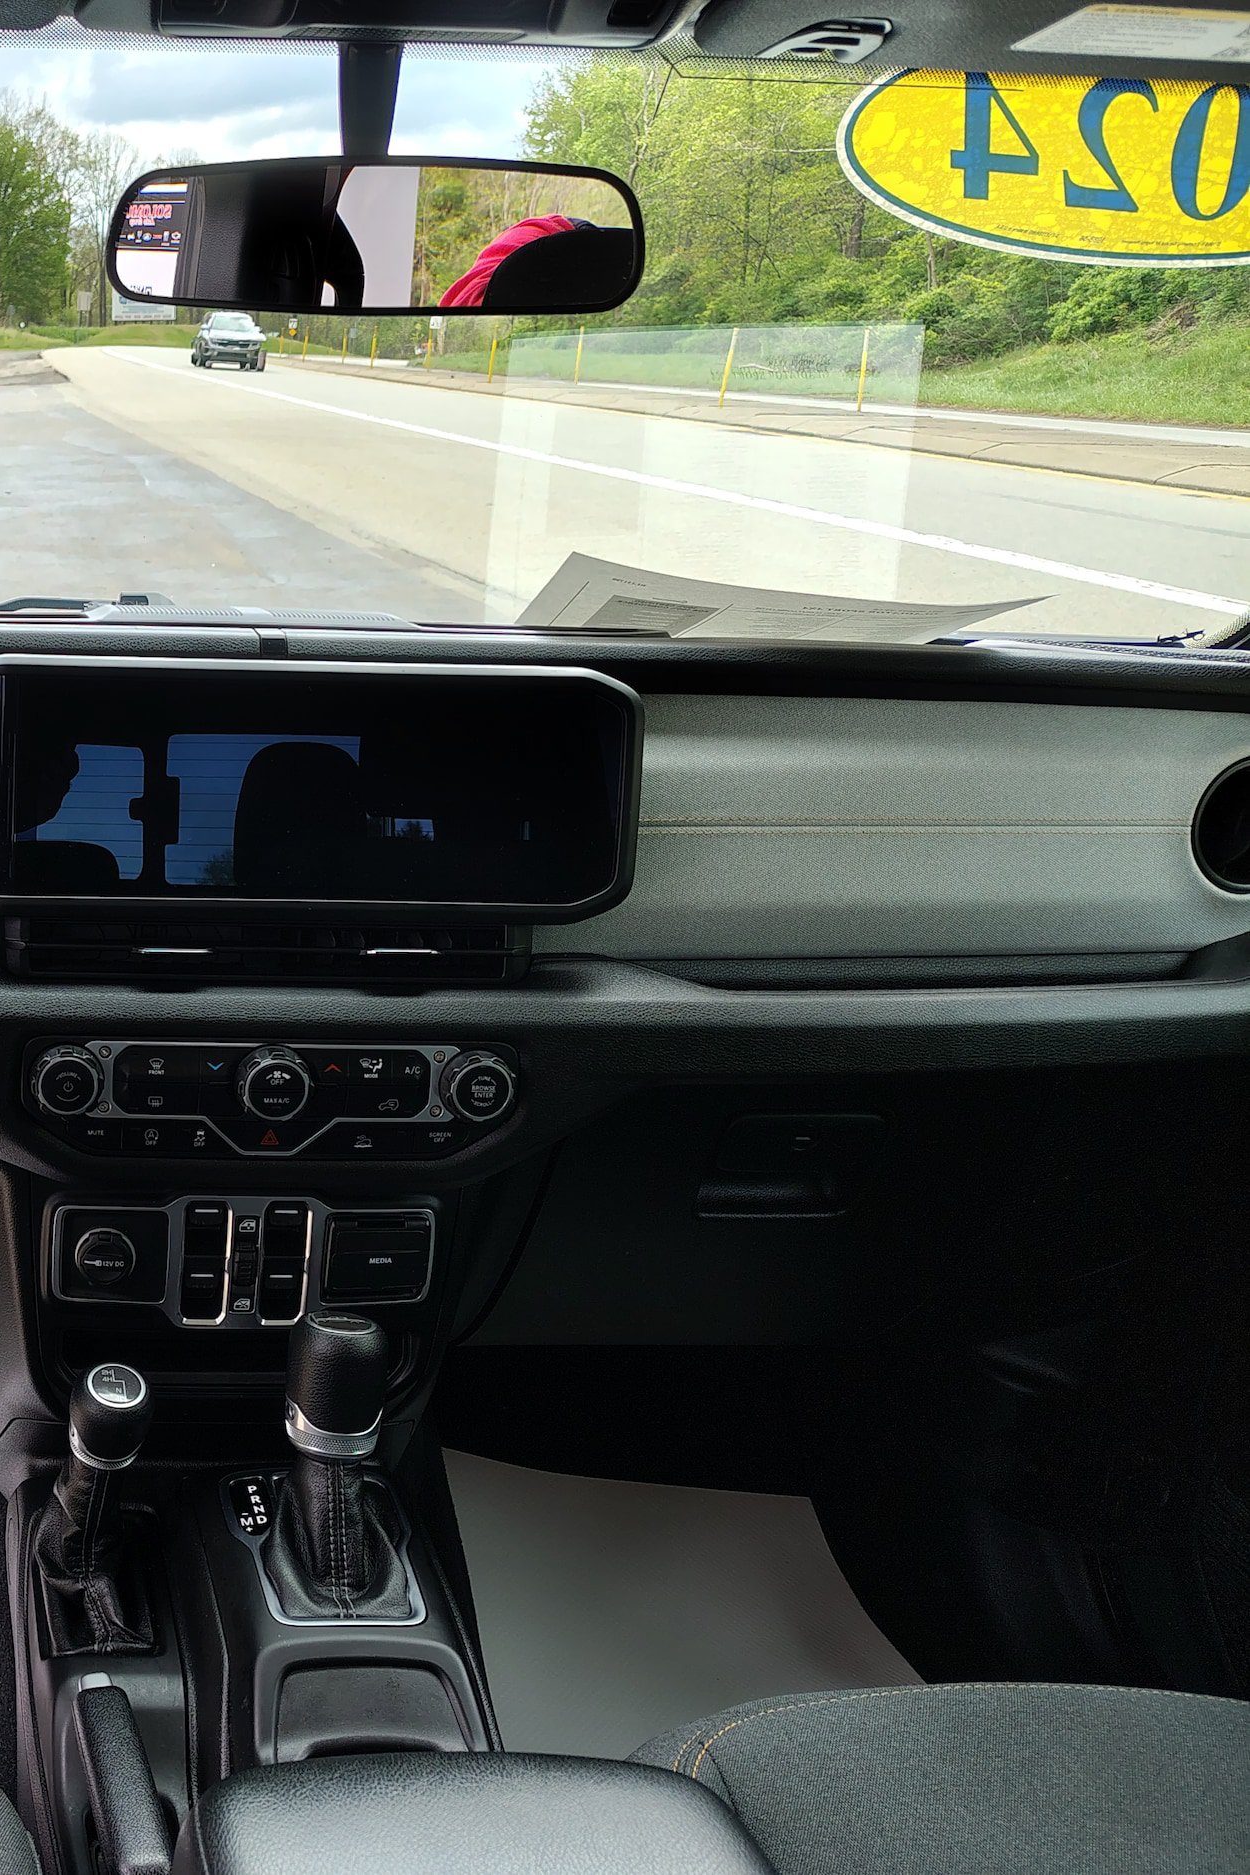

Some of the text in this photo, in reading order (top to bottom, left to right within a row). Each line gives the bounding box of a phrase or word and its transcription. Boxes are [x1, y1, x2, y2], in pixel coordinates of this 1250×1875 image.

[59, 1070, 78, 1079] VOLUME
[404, 1065, 421, 1076] A/C
[270, 1078, 285, 1086] OFF
[277, 1097, 290, 1105] A/C
[473, 1100, 493, 1108] SCROLL
[369, 1257, 393, 1266] MEDIA
[247, 1485, 258, 1494] P
[250, 1495, 262, 1504] R
[253, 1505, 265, 1514] N
[240, 1517, 254, 1526] M
[256, 1515, 267, 1524] D
